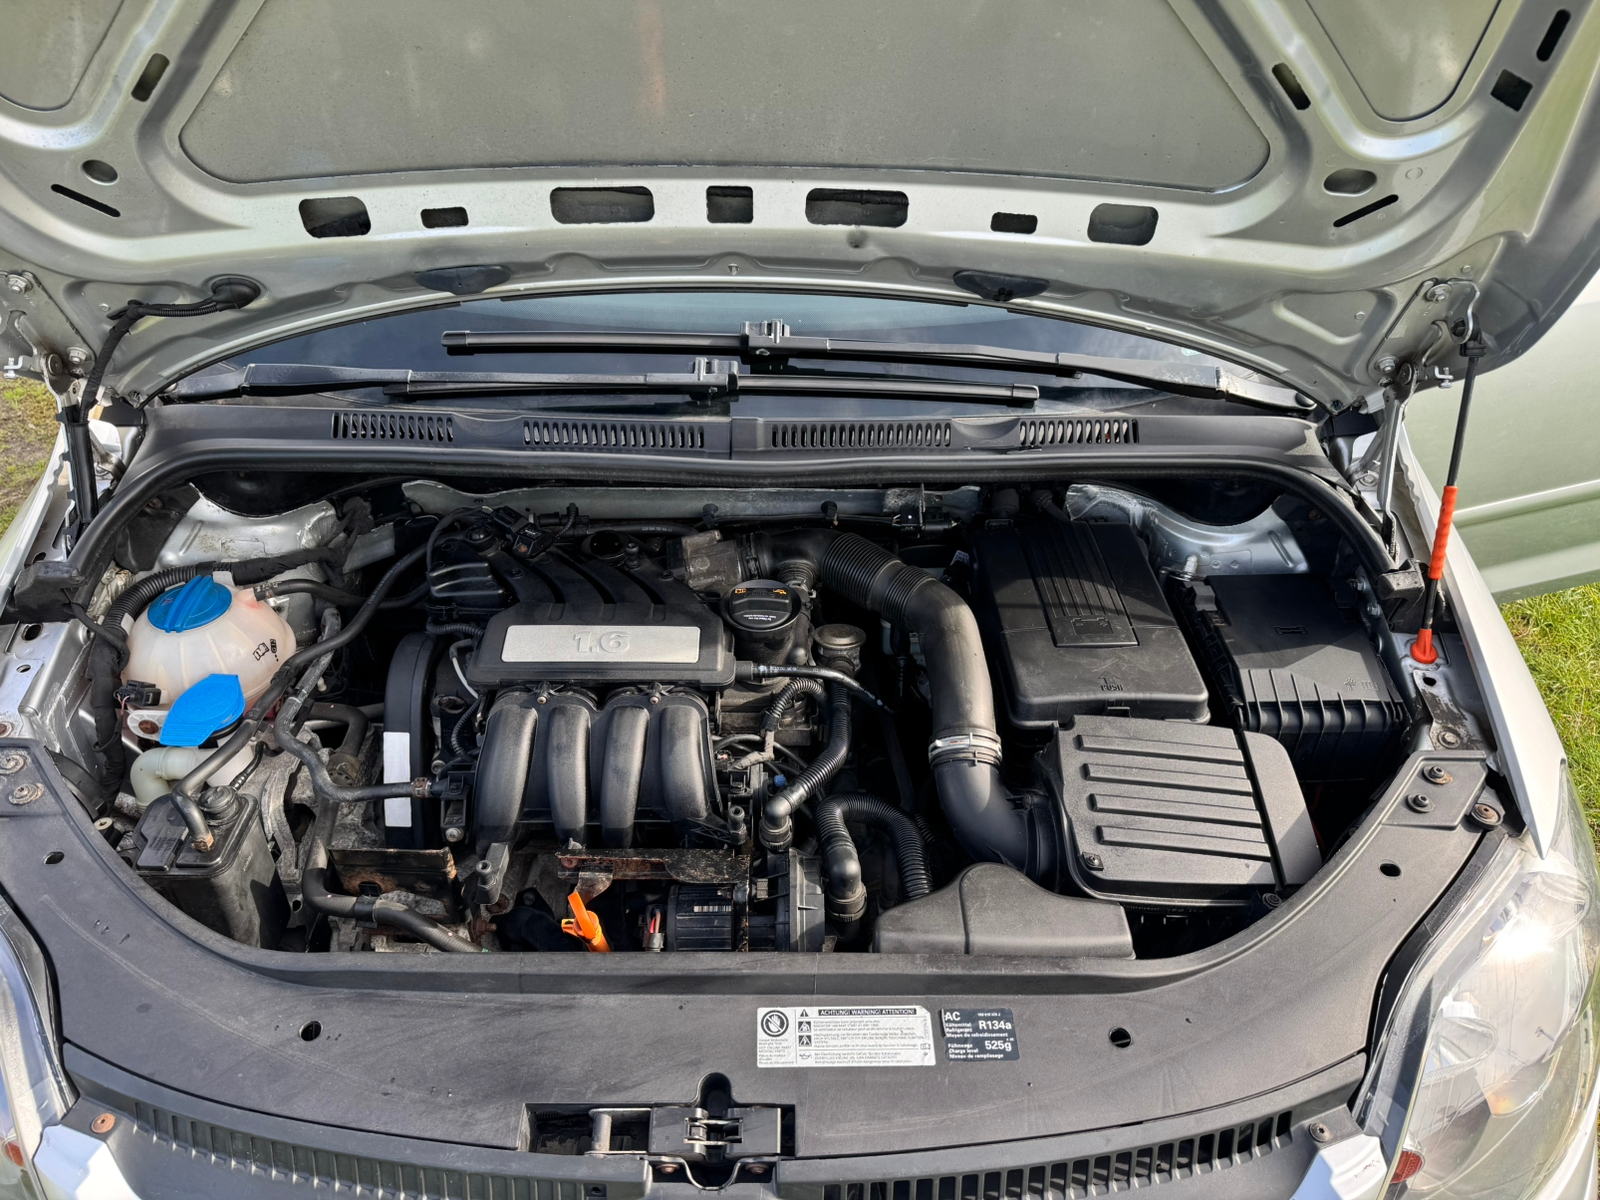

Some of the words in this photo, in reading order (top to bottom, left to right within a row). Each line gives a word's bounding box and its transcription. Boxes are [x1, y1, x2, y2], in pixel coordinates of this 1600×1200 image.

[573, 630, 630, 654] 1.6
[945, 1011, 961, 1021] AC
[978, 1020, 1012, 1030] R134a
[984, 1040, 1012, 1052] 525g
